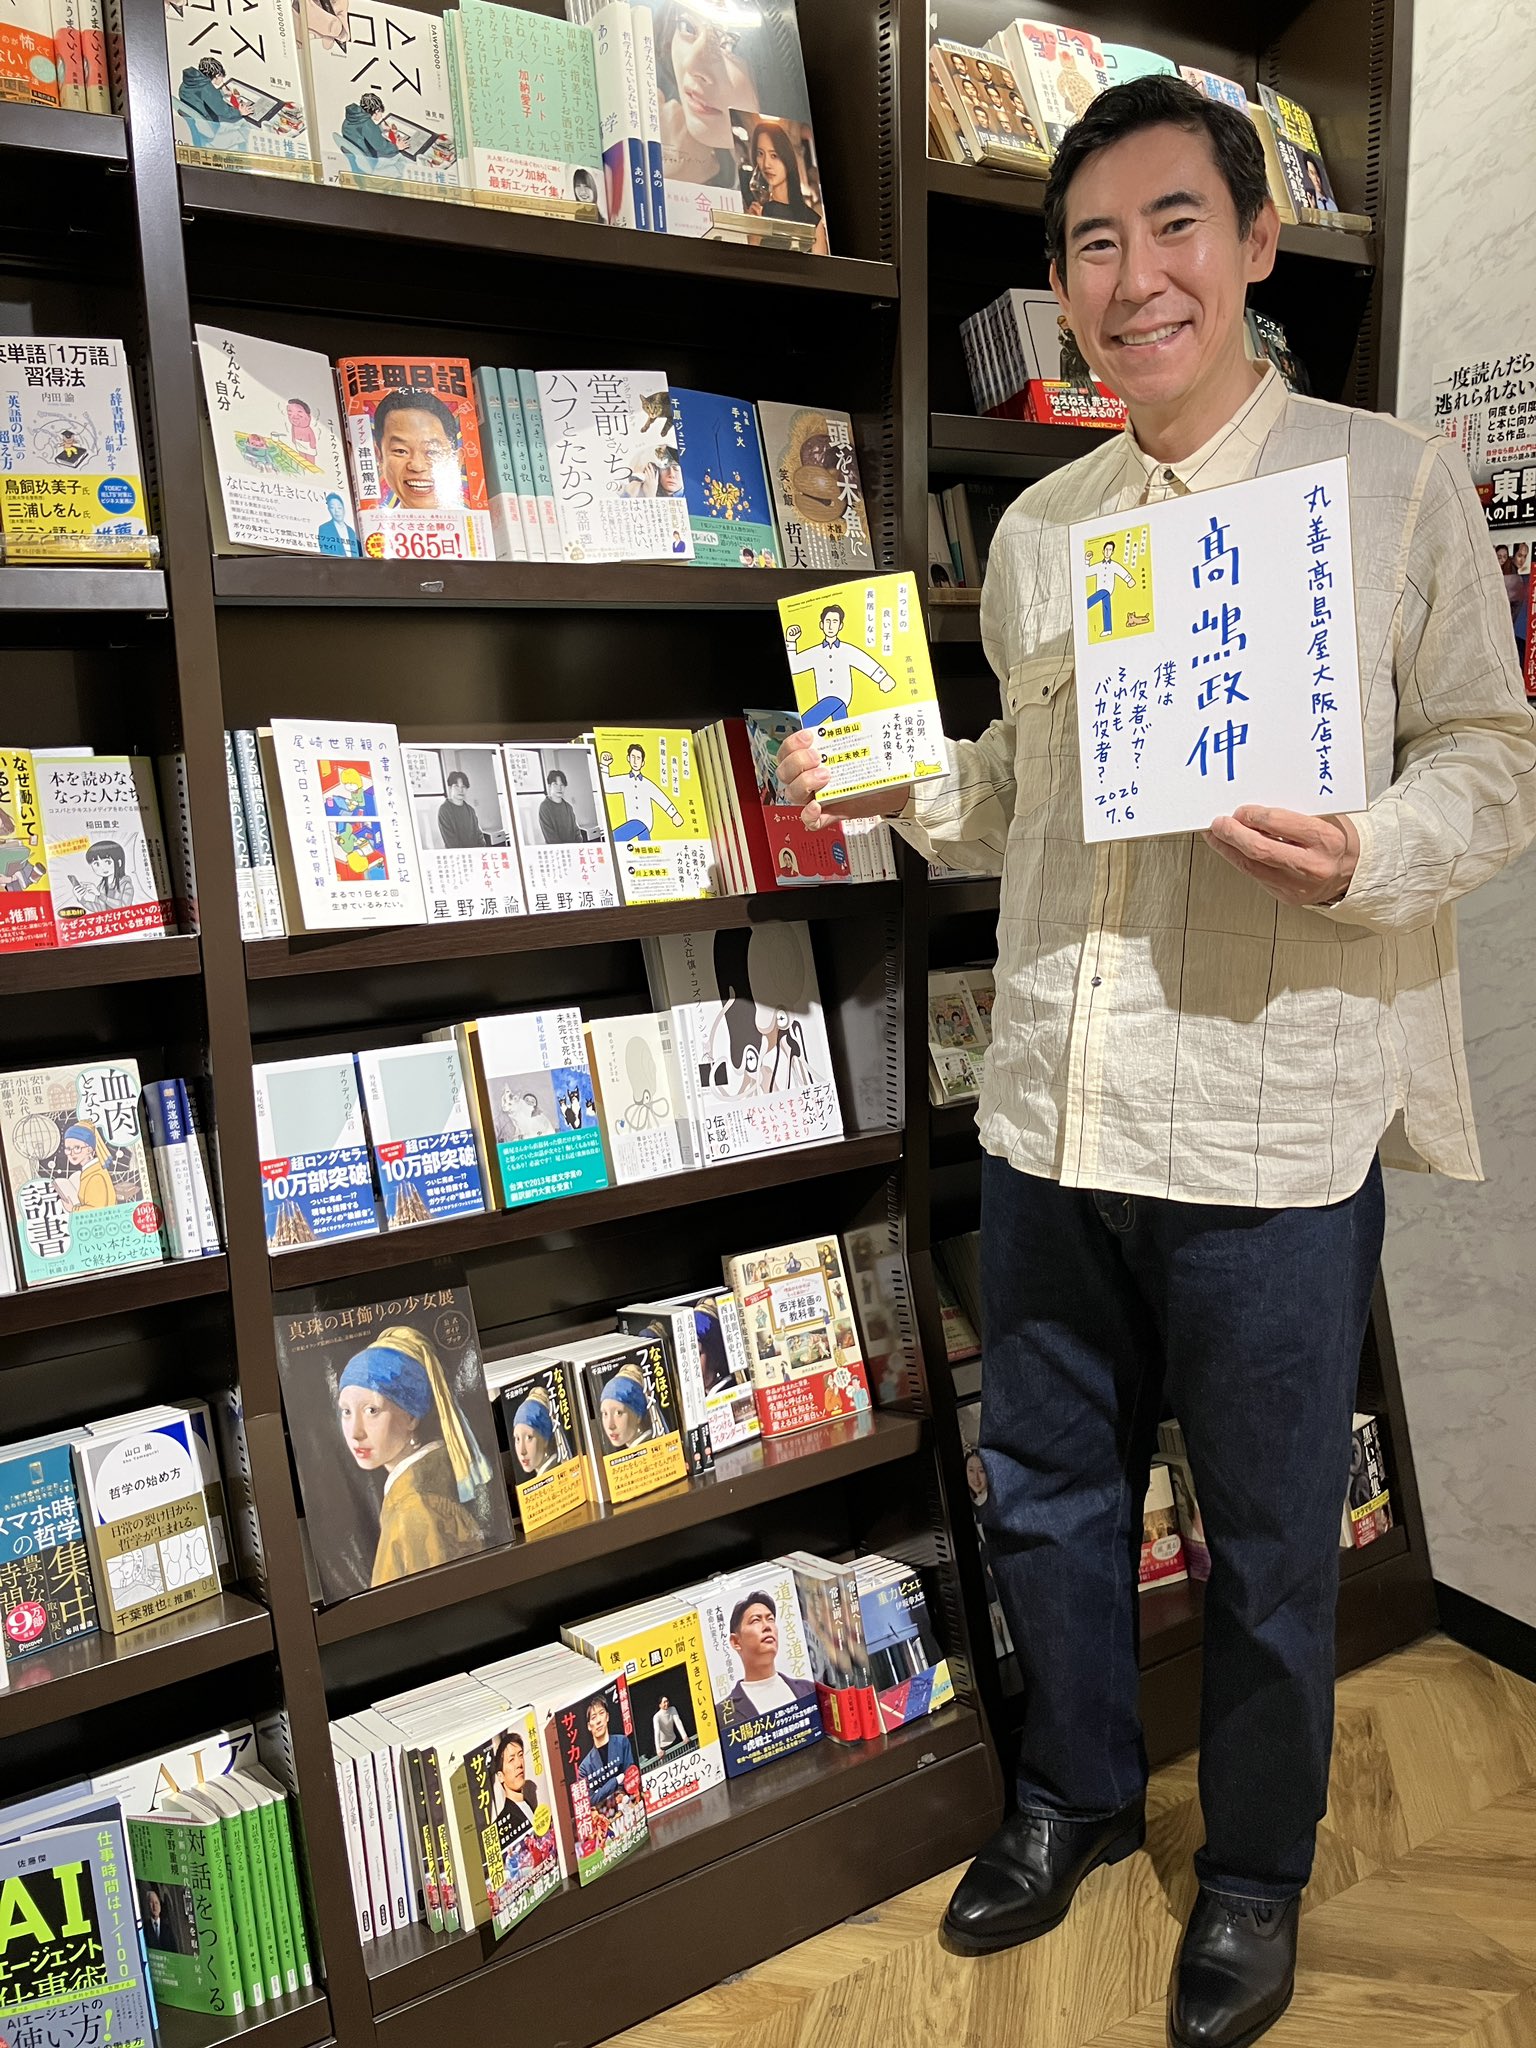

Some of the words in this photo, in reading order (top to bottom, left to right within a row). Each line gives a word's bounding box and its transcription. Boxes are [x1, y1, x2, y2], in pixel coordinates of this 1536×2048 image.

[430, 24, 441, 70] DAW90000
[518, 69, 532, 119] 加納愛子
[534, 73, 547, 121] バルト
[622, 32, 640, 130] 哲学なんていらない哲学
[643, 36, 659, 133] 哲学なんていらない哲学
[488, 164, 552, 184] Aマッソ加納、
[634, 166, 645, 185] あの
[653, 169, 663, 188] あの
[0, 343, 119, 367] 単語「1万語」
[222, 339, 246, 401] なんなん
[1433, 353, 1536, 391] 一度読んだら
[24, 367, 86, 388] 習得法
[215, 380, 231, 412] 自分
[346, 362, 469, 399] 津田日記
[1434, 379, 1536, 417] 逃れられない。
[5, 390, 25, 461] 「英語の壁」の
[356, 418, 367, 445] ダイアン
[545, 374, 594, 509] ハフとたかつ
[587, 373, 634, 493] 堂前さんちの
[671, 398, 687, 457] 千原ジュニア
[731, 406, 746, 448] 手花火
[1487, 431, 1527, 444] なる作品。
[0, 430, 13, 471] 超え方
[104, 435, 117, 471] が明かす
[358, 447, 378, 496] 津田篤宏
[779, 468, 795, 507] 笑い飯
[825, 418, 868, 557] 頭を木魚に
[7, 502, 82, 518] 三浦しをん
[394, 533, 463, 559] 365日！
[785, 521, 808, 569] 哲夫
[866, 590, 876, 646] 長居しない
[899, 586, 909, 629] おつむの
[882, 608, 893, 653] 良い子は
[1113, 666, 1128, 732] それとも
[1154, 661, 1177, 706] 僕は
[293, 734, 387, 751] 尾崎世界観の
[827, 723, 860, 738] 神田伯山
[917, 708, 928, 741] この男、
[1093, 676, 1113, 784] バカ役者？
[1129, 679, 1152, 769] 役者バカ？
[659, 738, 668, 785] 長居しない
[671, 756, 680, 794] 良い子は
[682, 740, 690, 777] おつむの
[828, 747, 869, 765] 川上未映子
[13, 756, 37, 837] なぜ働いて
[50, 770, 137, 788] 本を読めなく
[54, 787, 140, 804] なった人たち
[1095, 780, 1139, 806] 2026
[85, 819, 120, 830] 稲田豊史
[380, 756, 411, 883] 書かなかったこと日記
[1106, 807, 1135, 825] 7.6
[304, 821, 325, 887] 尾崎世界観
[8, 906, 47, 924] 推薦！
[59, 902, 172, 932] なぜスマホだけでいいのか？
[331, 901, 404, 911] 生きているみたい。
[434, 895, 519, 919] 星野源論
[535, 888, 614, 912] 星野源論
[61, 912, 173, 942] そこから見えている世界とは？
[535, 1015, 551, 1069] 横尾忠則自伝
[556, 1014, 573, 1066] 未完で死ぬ
[571, 1012, 586, 1065] 未完で生まれて
[15, 1077, 31, 1116] 小川公代
[81, 1073, 101, 1124] となる
[100, 1068, 139, 1142] 血肉
[339, 1068, 356, 1131] ガウディの伝言
[445, 1054, 462, 1114] ガウディの伝言
[822, 1083, 835, 1116] ブック
[165, 1099, 181, 1140] 高速読書
[787, 1098, 801, 1138] すること
[801, 1087, 818, 1125] ぜんぶ
[813, 1086, 830, 1132] デザイン
[405, 1131, 473, 1155] 超ロングセラー
[713, 1114, 731, 1155] 伝説の
[290, 1146, 369, 1172] 超ロングセラー
[381, 1143, 479, 1183] 10万部突破！
[262, 1161, 373, 1201] 10万部突破！
[20, 1181, 71, 1258] 読書
[288, 1288, 456, 1342] 真珠の耳飾りの少女展
[778, 1294, 823, 1314] 西洋絵画の
[788, 1306, 818, 1324] 教科書
[720, 1303, 735, 1355] 西洋美術史
[727, 1302, 746, 1366] 1時間でわかる
[636, 1349, 666, 1440] フェルメール
[649, 1345, 671, 1408] なるほど
[543, 1371, 569, 1464] フェルメール
[553, 1366, 572, 1431] なるほど
[713, 1422, 747, 1445] スタンダード
[108, 1466, 182, 1501] 哲学の始め方
[13, 1516, 82, 1556] の哲学
[110, 1501, 200, 1540] 日常の裂け目から、
[118, 1515, 198, 1552] 哲学が生まれる。
[21, 1554, 46, 1608] 豊かな
[47, 1541, 97, 1632] 集中
[876, 1577, 923, 1607] 重力ピエロ
[7, 1608, 35, 1636] 9
[31, 1606, 47, 1629] 万部
[47, 1599, 64, 1641] 取り戻し
[774, 1579, 806, 1679] 道なき道を
[689, 1651, 714, 1727] 生きている。
[561, 1711, 582, 1783] サッカー
[728, 1715, 777, 1748] 大腸がん
[470, 1754, 491, 1825] サッカー
[570, 1779, 595, 1842] 観戦術
[164, 1828, 180, 1876] 宇野重規
[213, 1837, 225, 1879] 対話をつくる
[233, 1830, 245, 1871] 対話をつくる
[251, 1823, 262, 1865] 対話をつくる
[481, 1823, 506, 1890] 観戦術
[0, 1860, 92, 1955] AI
[97, 1830, 130, 1978] 仕事時間は1/100
[186, 1828, 225, 2012] 対話をつくる
[0, 1937, 104, 1981] エージェント
[7, 1999, 104, 2030] AIエージェントの
